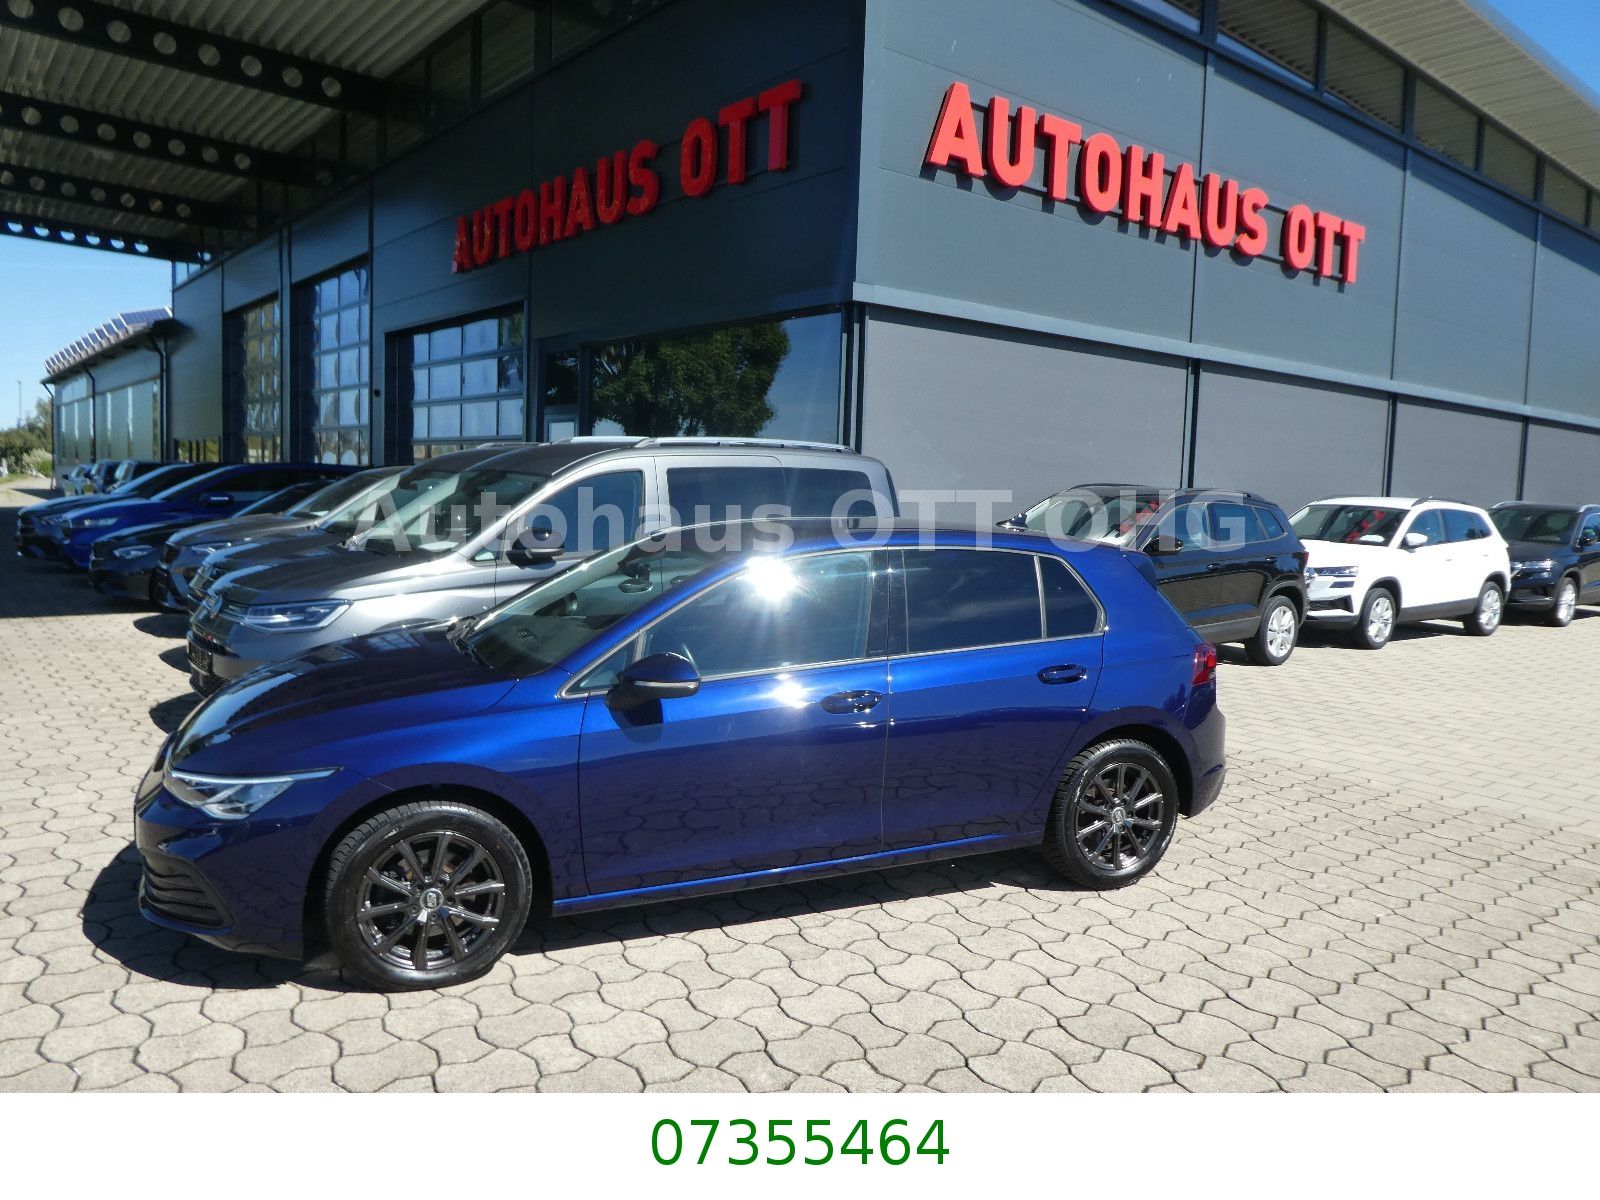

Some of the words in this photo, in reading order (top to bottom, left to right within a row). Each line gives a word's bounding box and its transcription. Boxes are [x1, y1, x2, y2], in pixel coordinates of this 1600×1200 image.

[452, 139, 660, 273] AUTOHAUS
[679, 78, 803, 198] OTT
[925, 81, 1269, 257] AUTOHAUS
[1284, 204, 1366, 284] OTT
